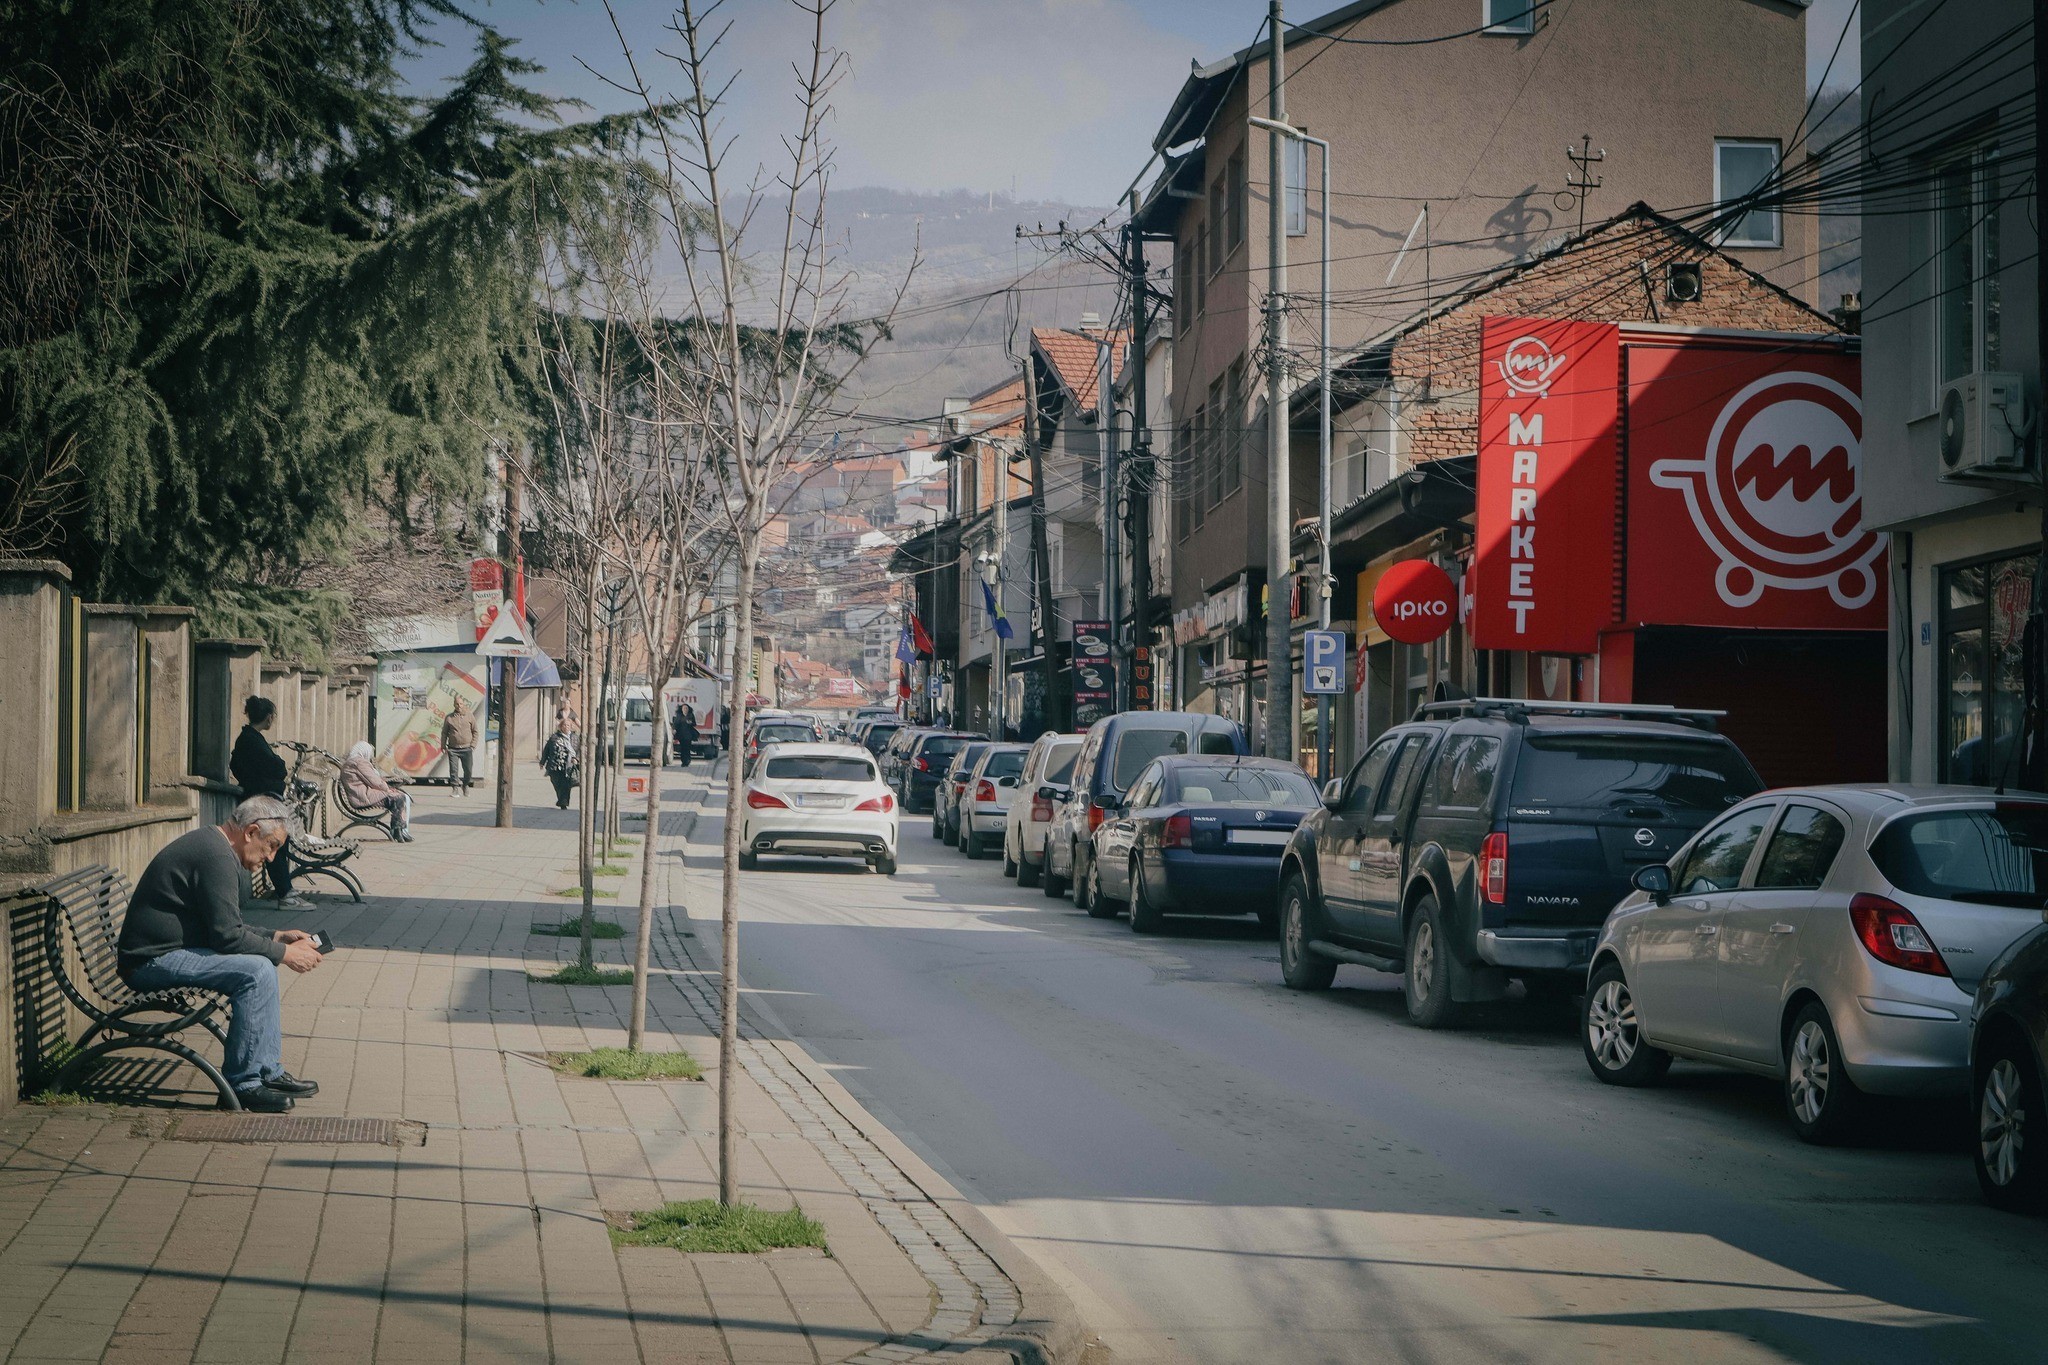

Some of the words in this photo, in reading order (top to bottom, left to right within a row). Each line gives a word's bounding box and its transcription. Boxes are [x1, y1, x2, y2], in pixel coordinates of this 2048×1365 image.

[1508, 412, 1543, 634] MARKET
[1313, 635, 1337, 664] P
[391, 663, 405, 672] 0%
[391, 673, 411, 681] SUGAR
[931, 677, 940, 688] P
[1527, 895, 1580, 906] NAVARA
[1942, 946, 1975, 954] CORSA
